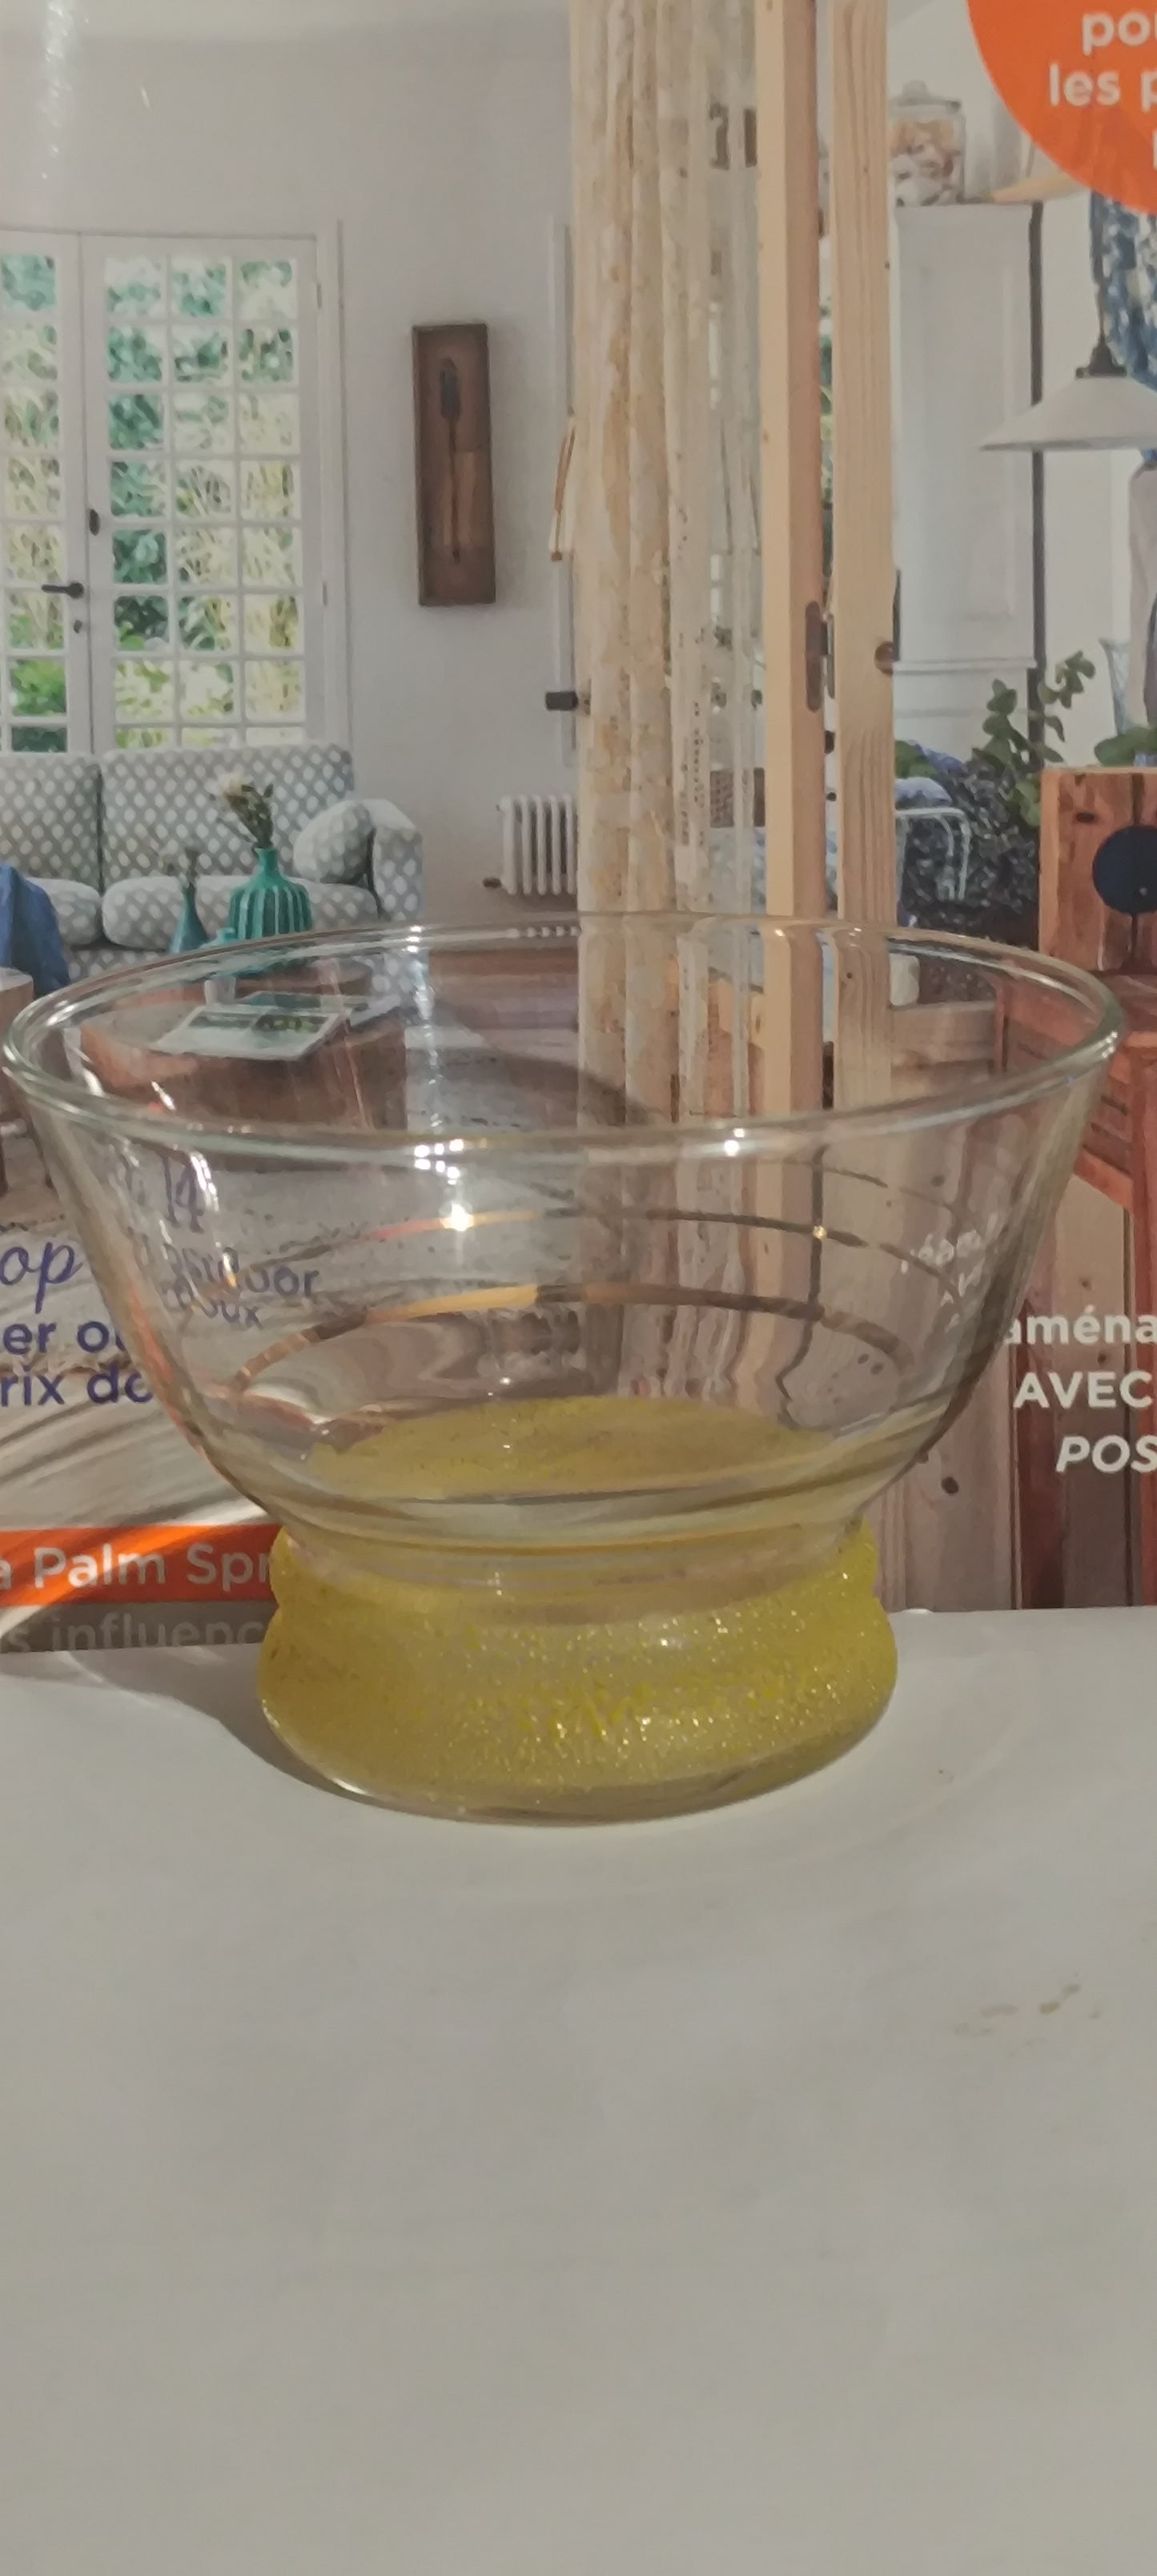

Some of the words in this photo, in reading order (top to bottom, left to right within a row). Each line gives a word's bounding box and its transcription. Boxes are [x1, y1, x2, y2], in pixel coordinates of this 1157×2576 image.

[1083, 10, 1157, 56] po
[1049, 61, 1121, 107] les
[3, 1323, 57, 1355] er
[1013, 1371, 1154, 1409] AVEC
[1055, 1435, 1157, 1473] POS
[34, 1543, 165, 1588] Palm
